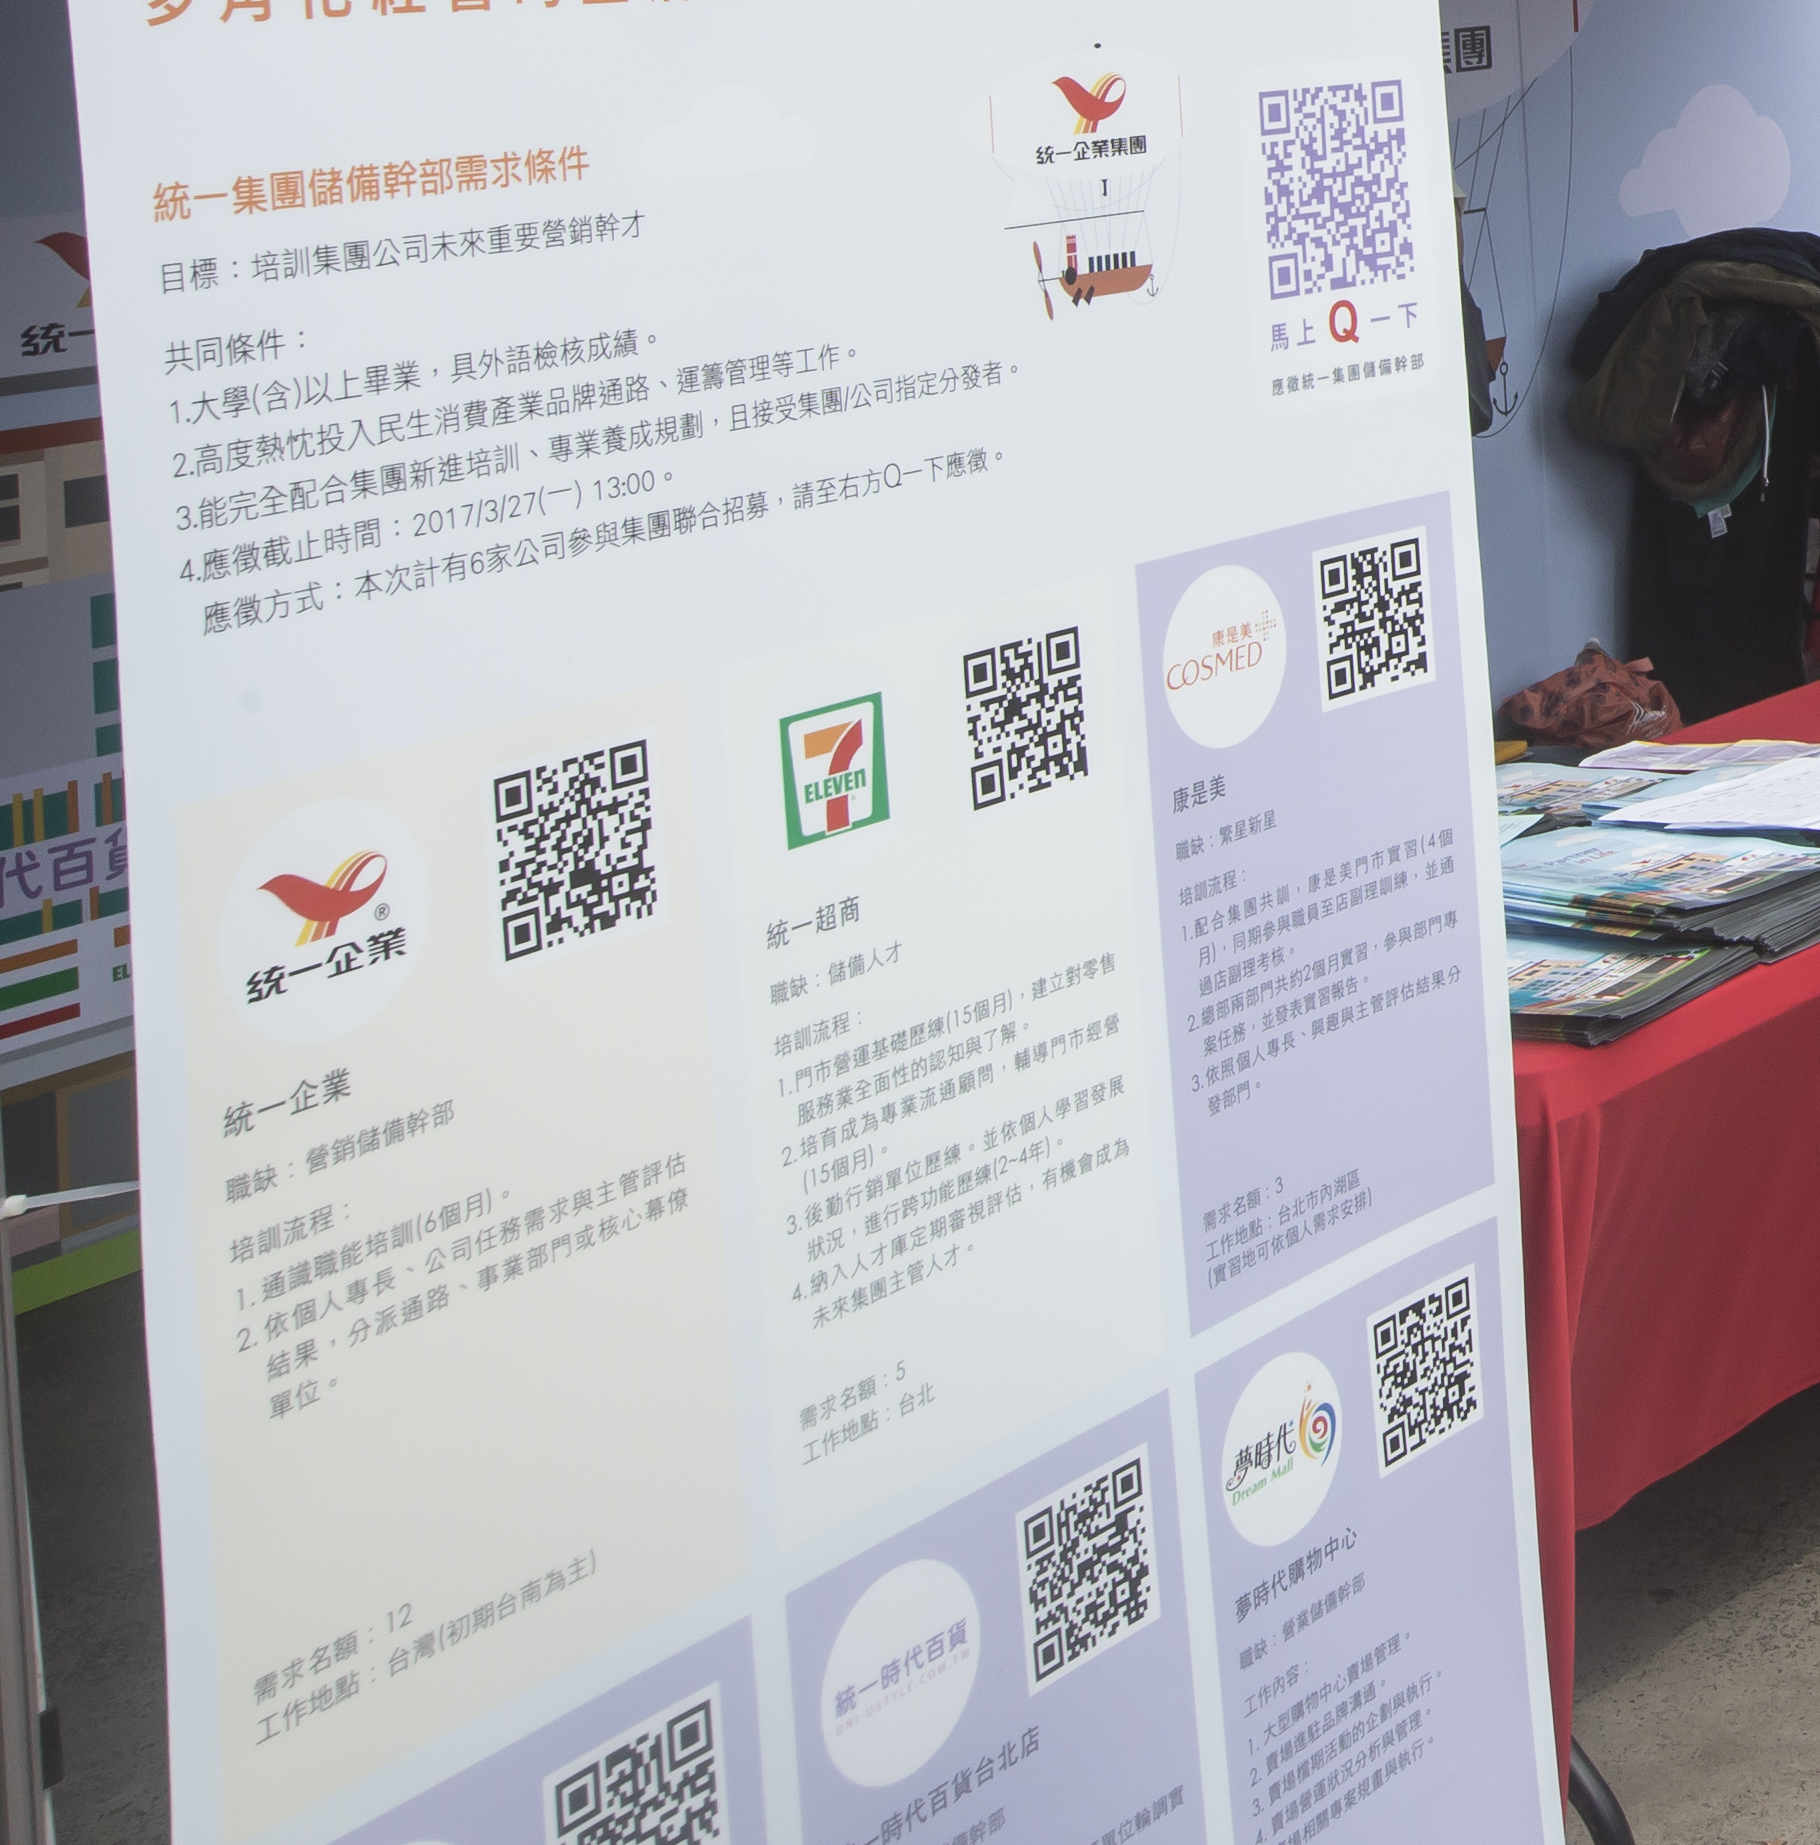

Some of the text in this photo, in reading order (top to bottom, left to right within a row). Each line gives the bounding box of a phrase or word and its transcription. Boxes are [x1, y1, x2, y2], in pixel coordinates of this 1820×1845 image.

[151, 143, 591, 224] 統一集團儲備幹部需求條件
[1035, 132, 1148, 169] 統一企業集團
[1166, 641, 1263, 692] COSMED
[1171, 773, 1227, 815] 康是美
[765, 894, 862, 952] 統一超商
[244, 925, 407, 1006] 統一企業
[221, 1067, 353, 1140] 統一企業
[1230, 1457, 1295, 1507] Dream Mall
[1234, 1526, 1359, 1625] 夢時代購物中心
[833, 1617, 969, 1719] 統一時代百貨
[843, 1724, 1042, 1845] 一時代百貨台北店
